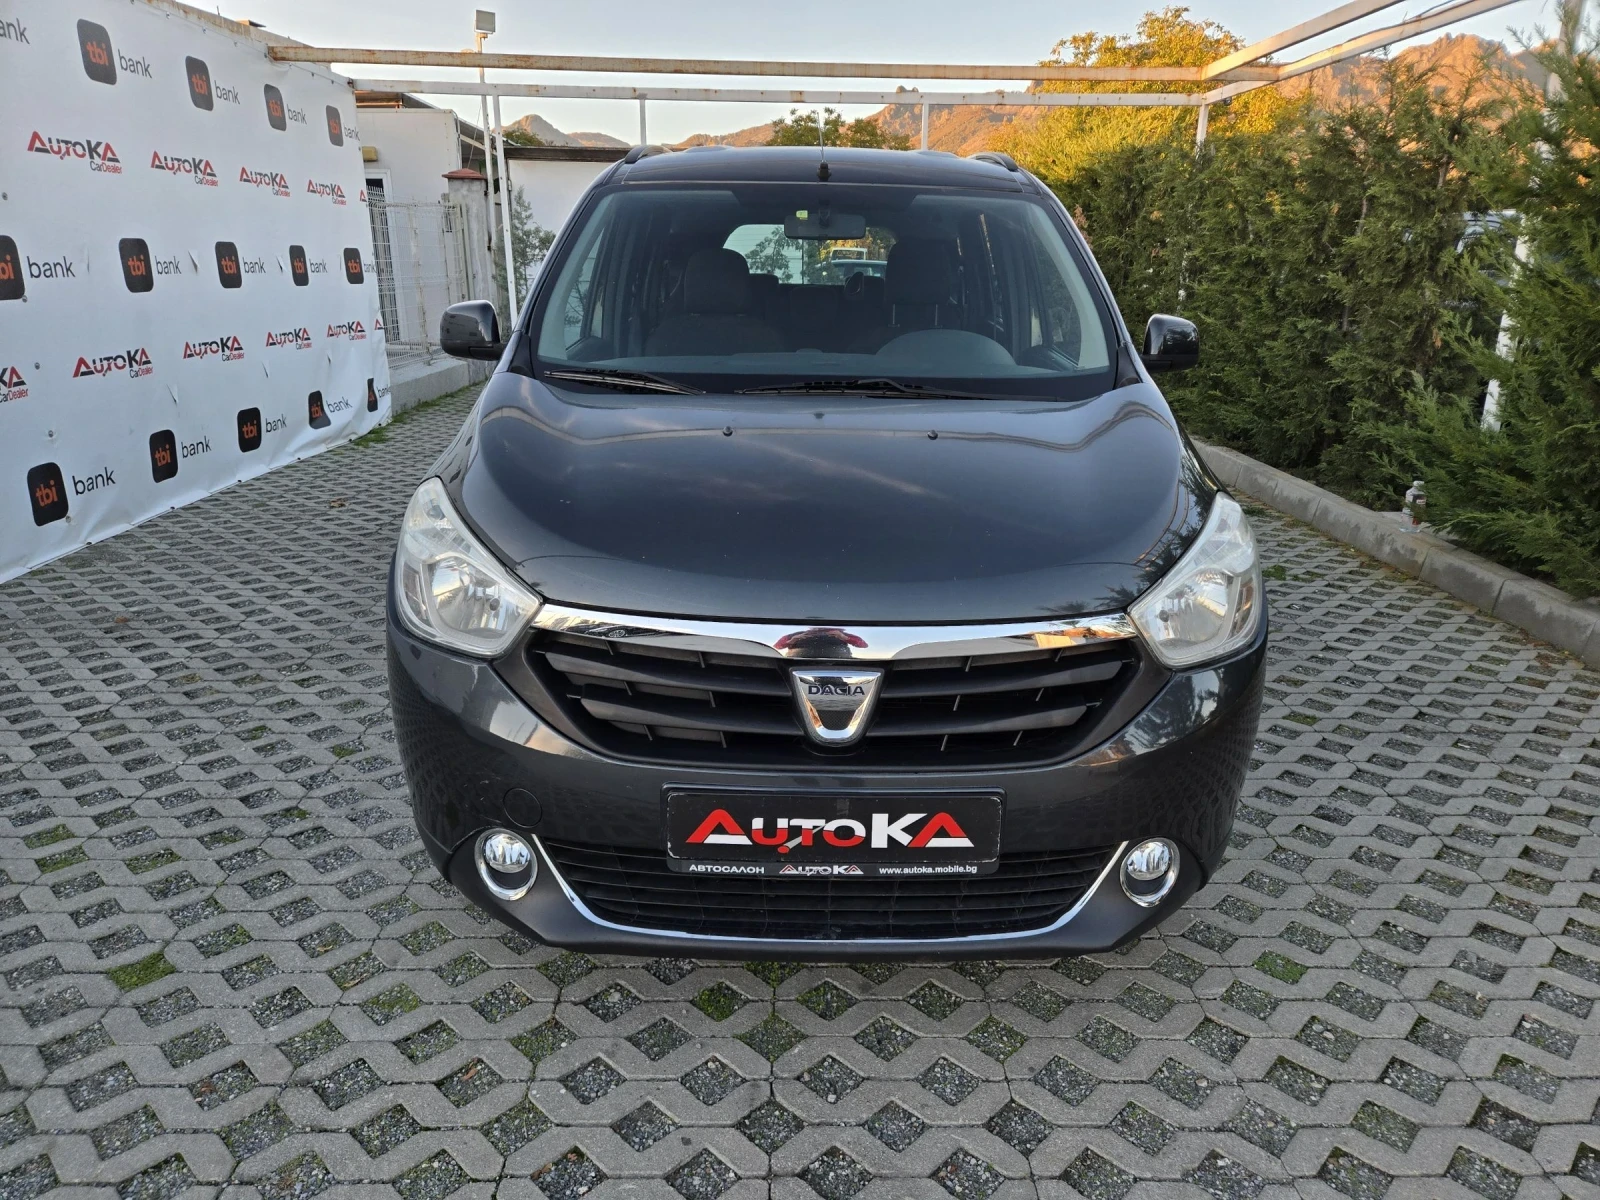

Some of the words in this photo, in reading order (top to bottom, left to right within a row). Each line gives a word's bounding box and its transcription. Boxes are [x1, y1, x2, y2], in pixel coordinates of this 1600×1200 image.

[0, 17, 30, 45] ank
[86, 41, 109, 66] tbi
[117, 49, 152, 79] bank
[191, 73, 208, 96] tbi
[214, 80, 241, 105] bank
[268, 99, 283, 118] tbi
[286, 104, 308, 125] bank
[329, 118, 340, 135] tbi
[343, 124, 361, 142] bank
[26, 255, 76, 279] bank
[127, 254, 147, 276] tbi
[154, 255, 182, 275] bank
[221, 255, 237, 275] tbi
[242, 257, 267, 274] bank
[293, 257, 305, 274] tbi
[309, 258, 328, 274] bank
[347, 259, 360, 273] tbi
[311, 401, 323, 419] tbi
[326, 396, 353, 414] bank
[242, 420, 258, 439] tbi
[265, 413, 288, 433] bank
[154, 444, 171, 467] tbi
[181, 435, 212, 459] bank
[35, 479, 58, 507] tbi
[72, 466, 116, 495] bank
[807, 684, 866, 696] DACIA
[689, 864, 765, 874] АВТОСАЛОН
[879, 865, 978, 876] www.autoka.mobile.bg
